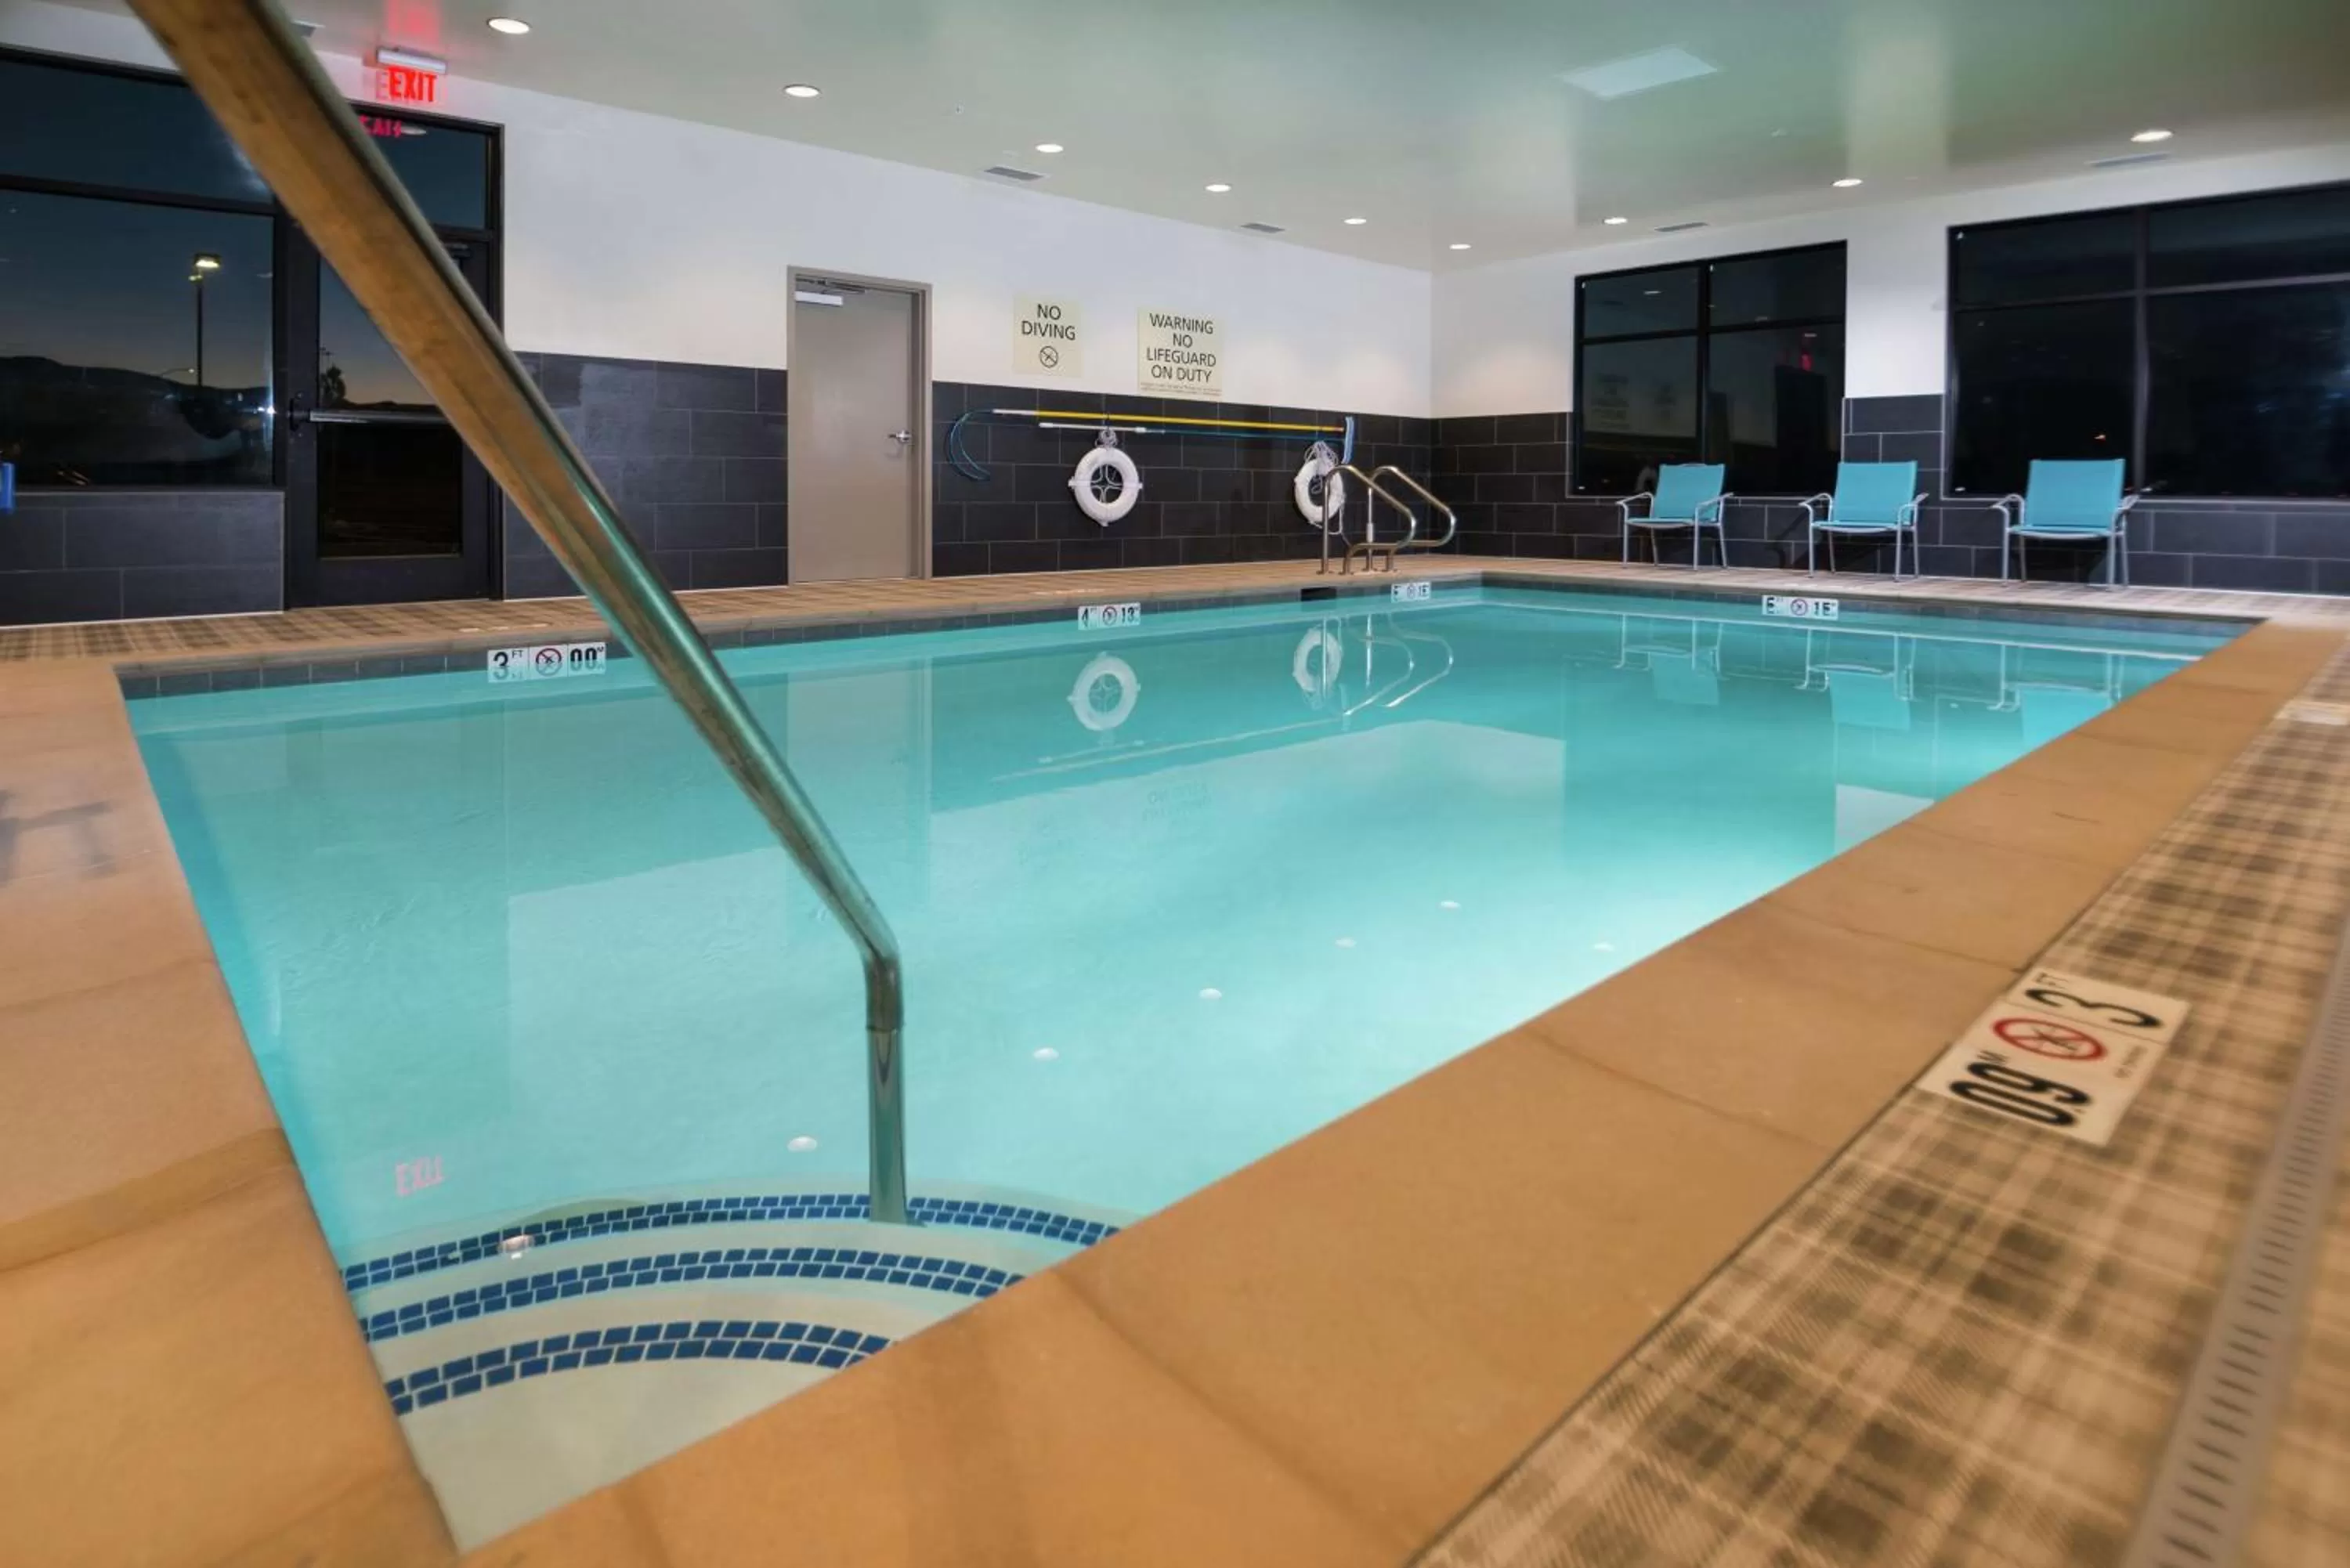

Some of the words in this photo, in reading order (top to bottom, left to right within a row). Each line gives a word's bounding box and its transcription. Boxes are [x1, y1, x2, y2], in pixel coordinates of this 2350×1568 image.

[388, 67, 437, 102] EXIT
[1037, 304, 1061, 320] NO
[1021, 320, 1076, 341] DIVING
[1150, 313, 1213, 335] WARNING
[1173, 334, 1193, 348] NO
[1147, 347, 1217, 367] LIFEGUARD
[1152, 365, 1172, 379] ON
[1177, 367, 1213, 383] DUTY
